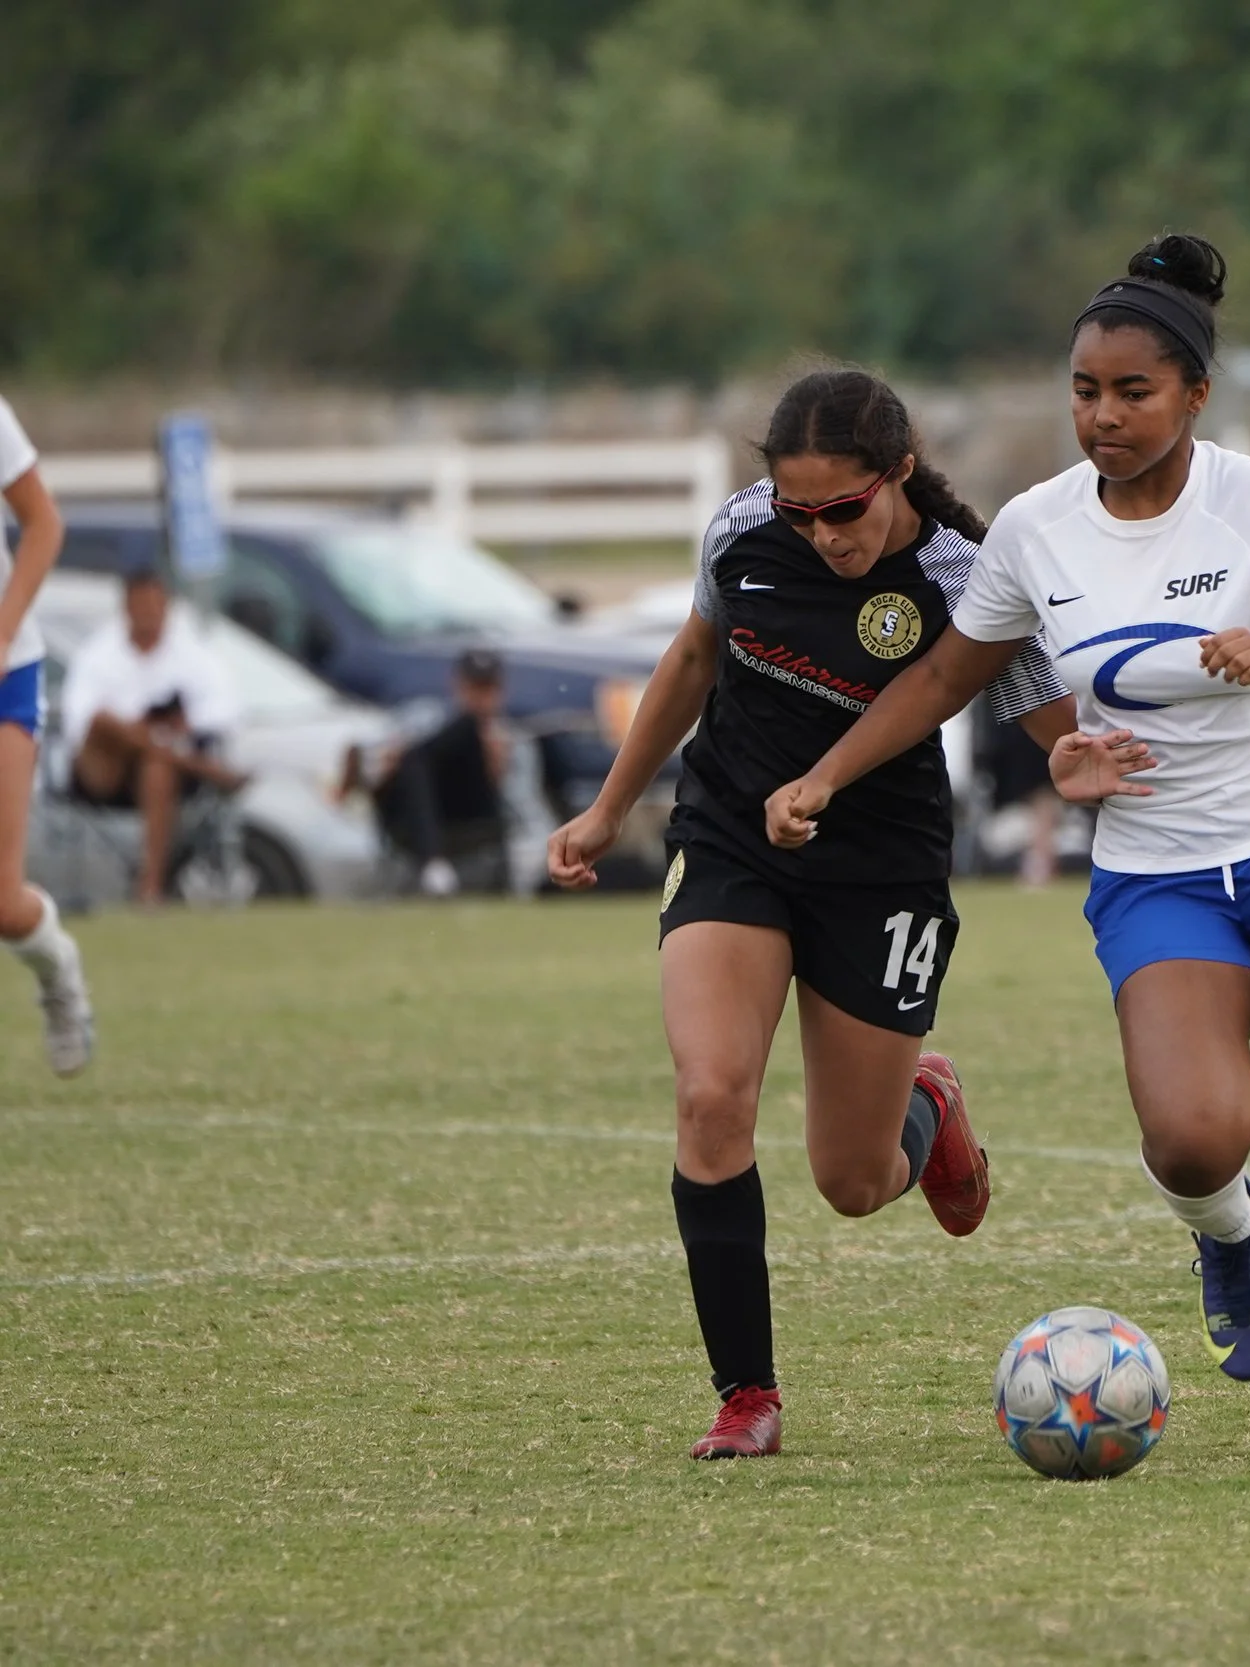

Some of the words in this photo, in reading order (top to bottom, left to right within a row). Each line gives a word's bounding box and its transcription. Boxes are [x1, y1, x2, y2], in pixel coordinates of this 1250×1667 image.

[1164, 569, 1228, 600] SURF
[870, 595, 899, 609] SOCAL
[900, 599, 919, 621] ELITE
[859, 623, 891, 657] FOOTBALL
[892, 638, 915, 656] CLUB
[731, 627, 878, 701] California
[882, 911, 943, 994] 14
